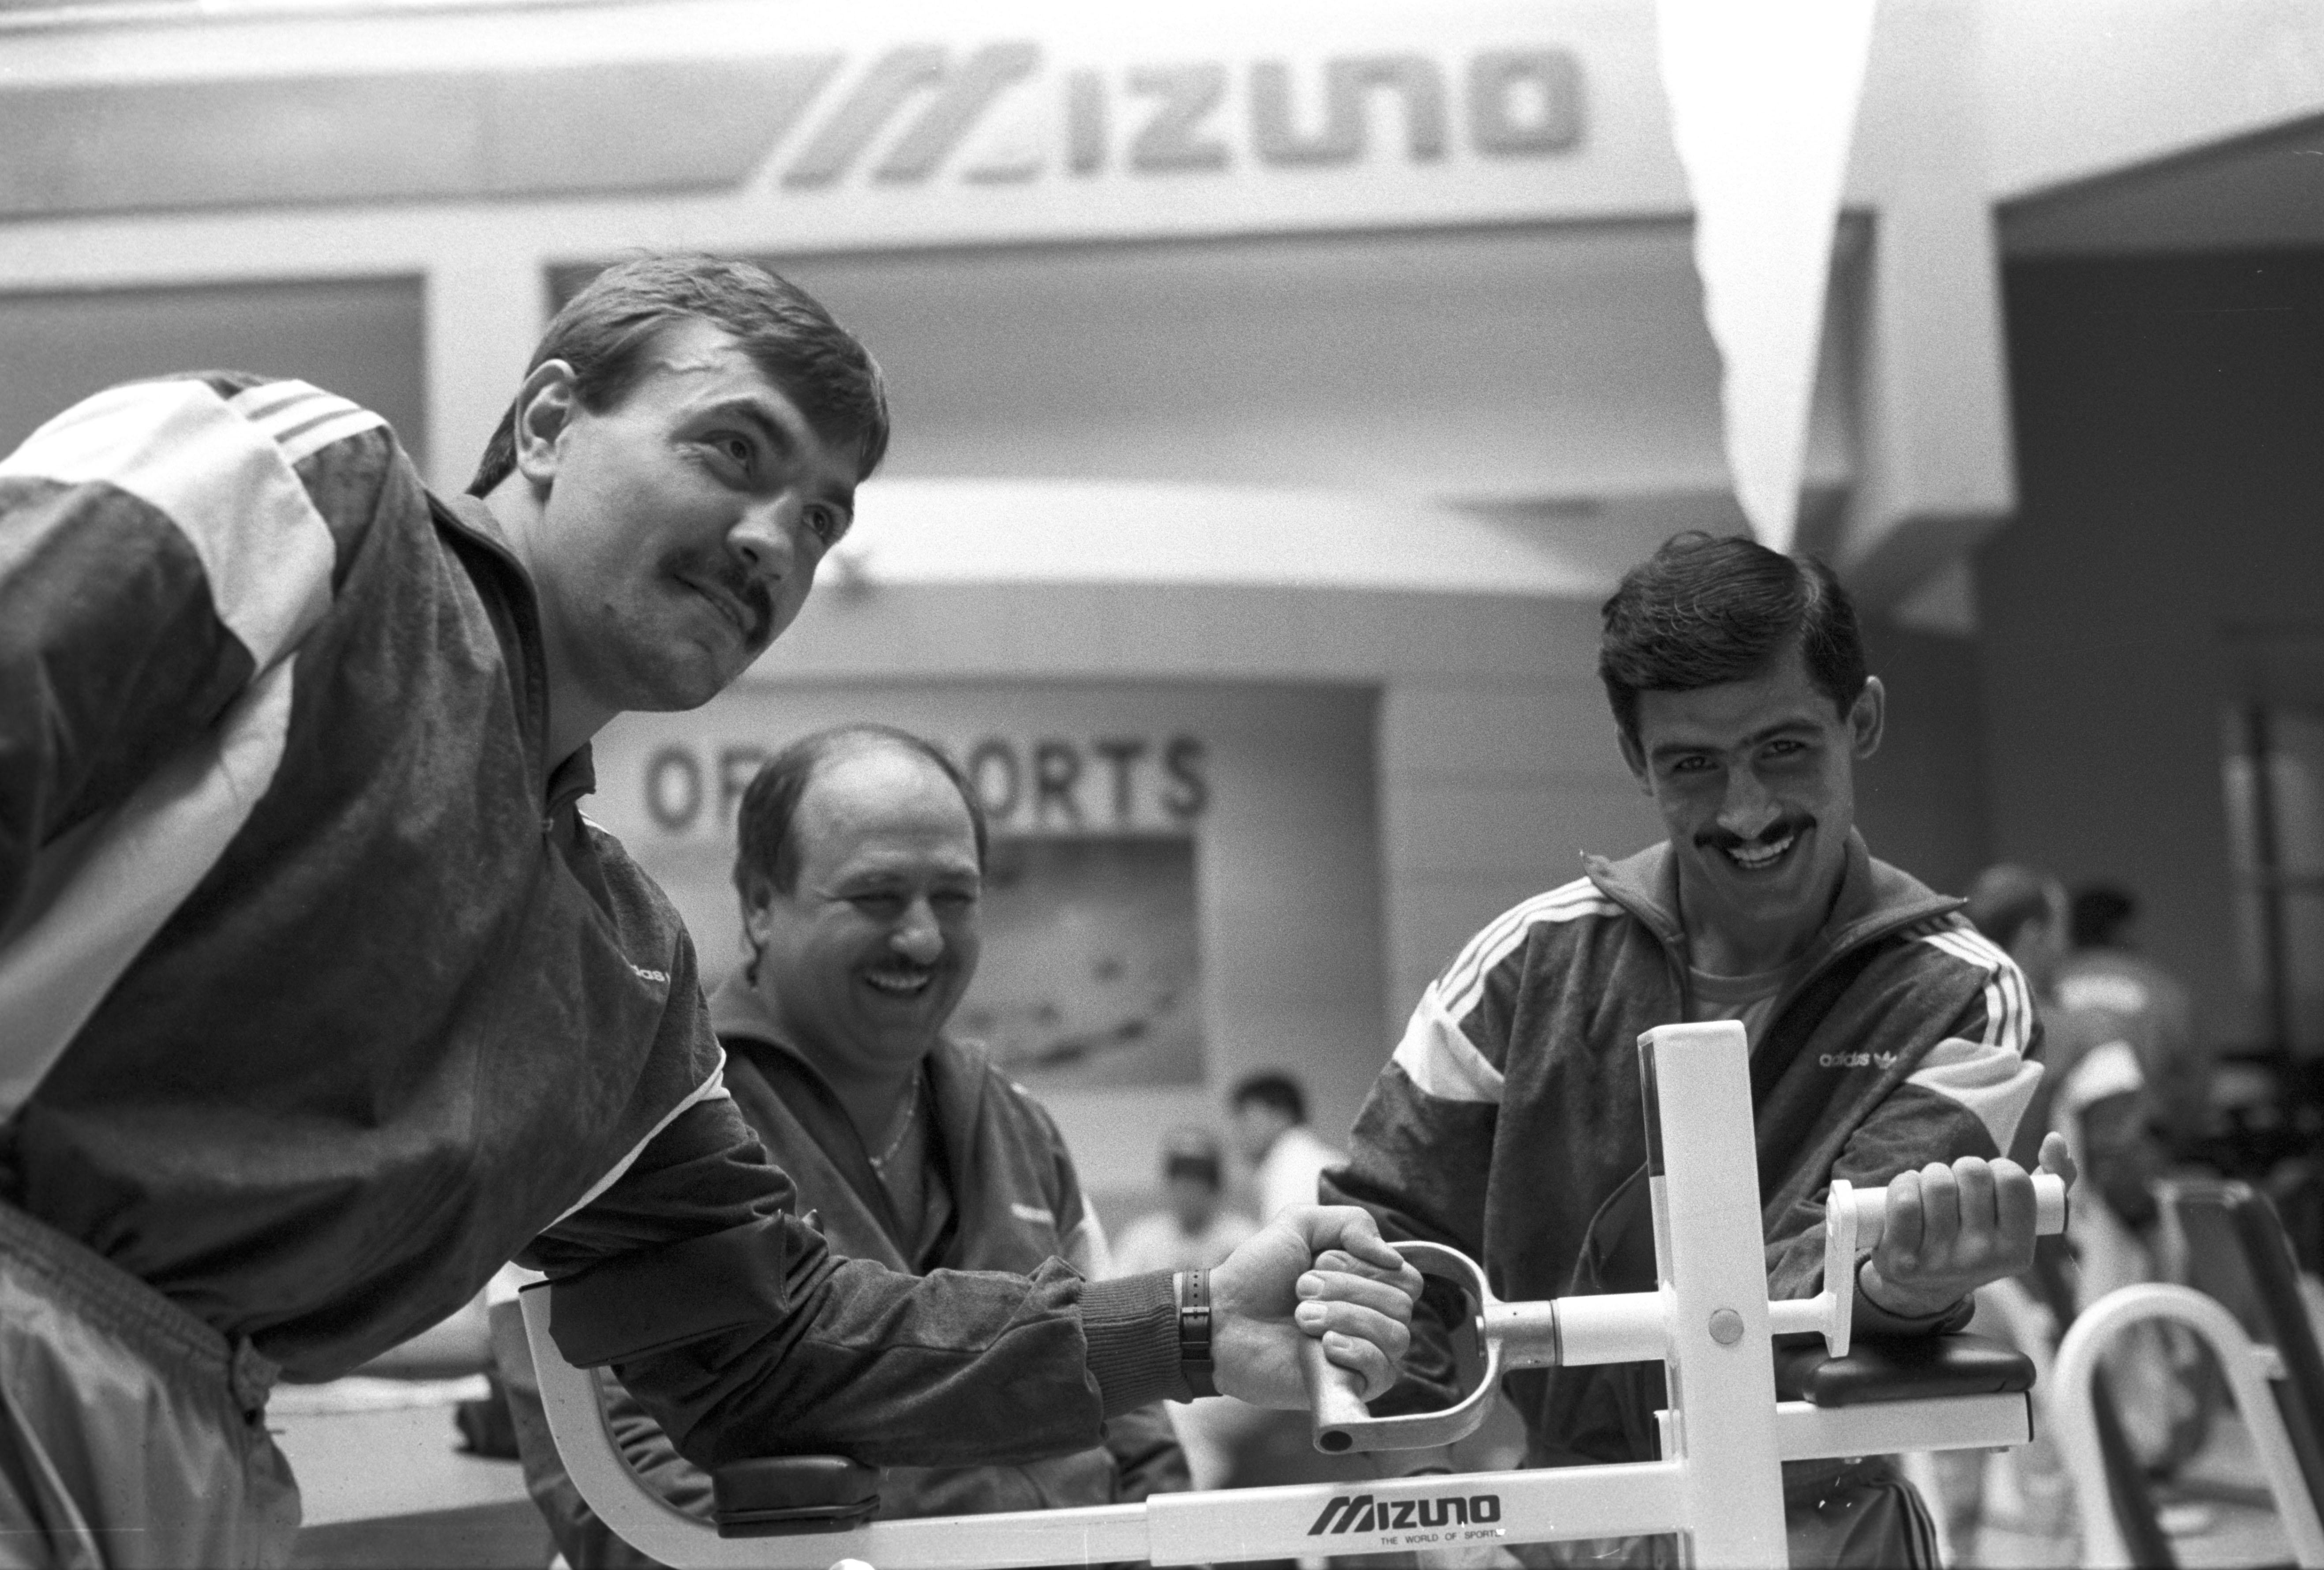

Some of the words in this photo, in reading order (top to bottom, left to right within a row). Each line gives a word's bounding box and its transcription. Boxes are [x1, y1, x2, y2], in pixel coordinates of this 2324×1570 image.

[972, 735, 1207, 831] ORTS
[1307, 1495, 1501, 1535] MIZUNO
[1381, 1536, 1398, 1545] THE
[1405, 1534, 1439, 1544] WORLD
[1445, 1532, 1457, 1541] OF
